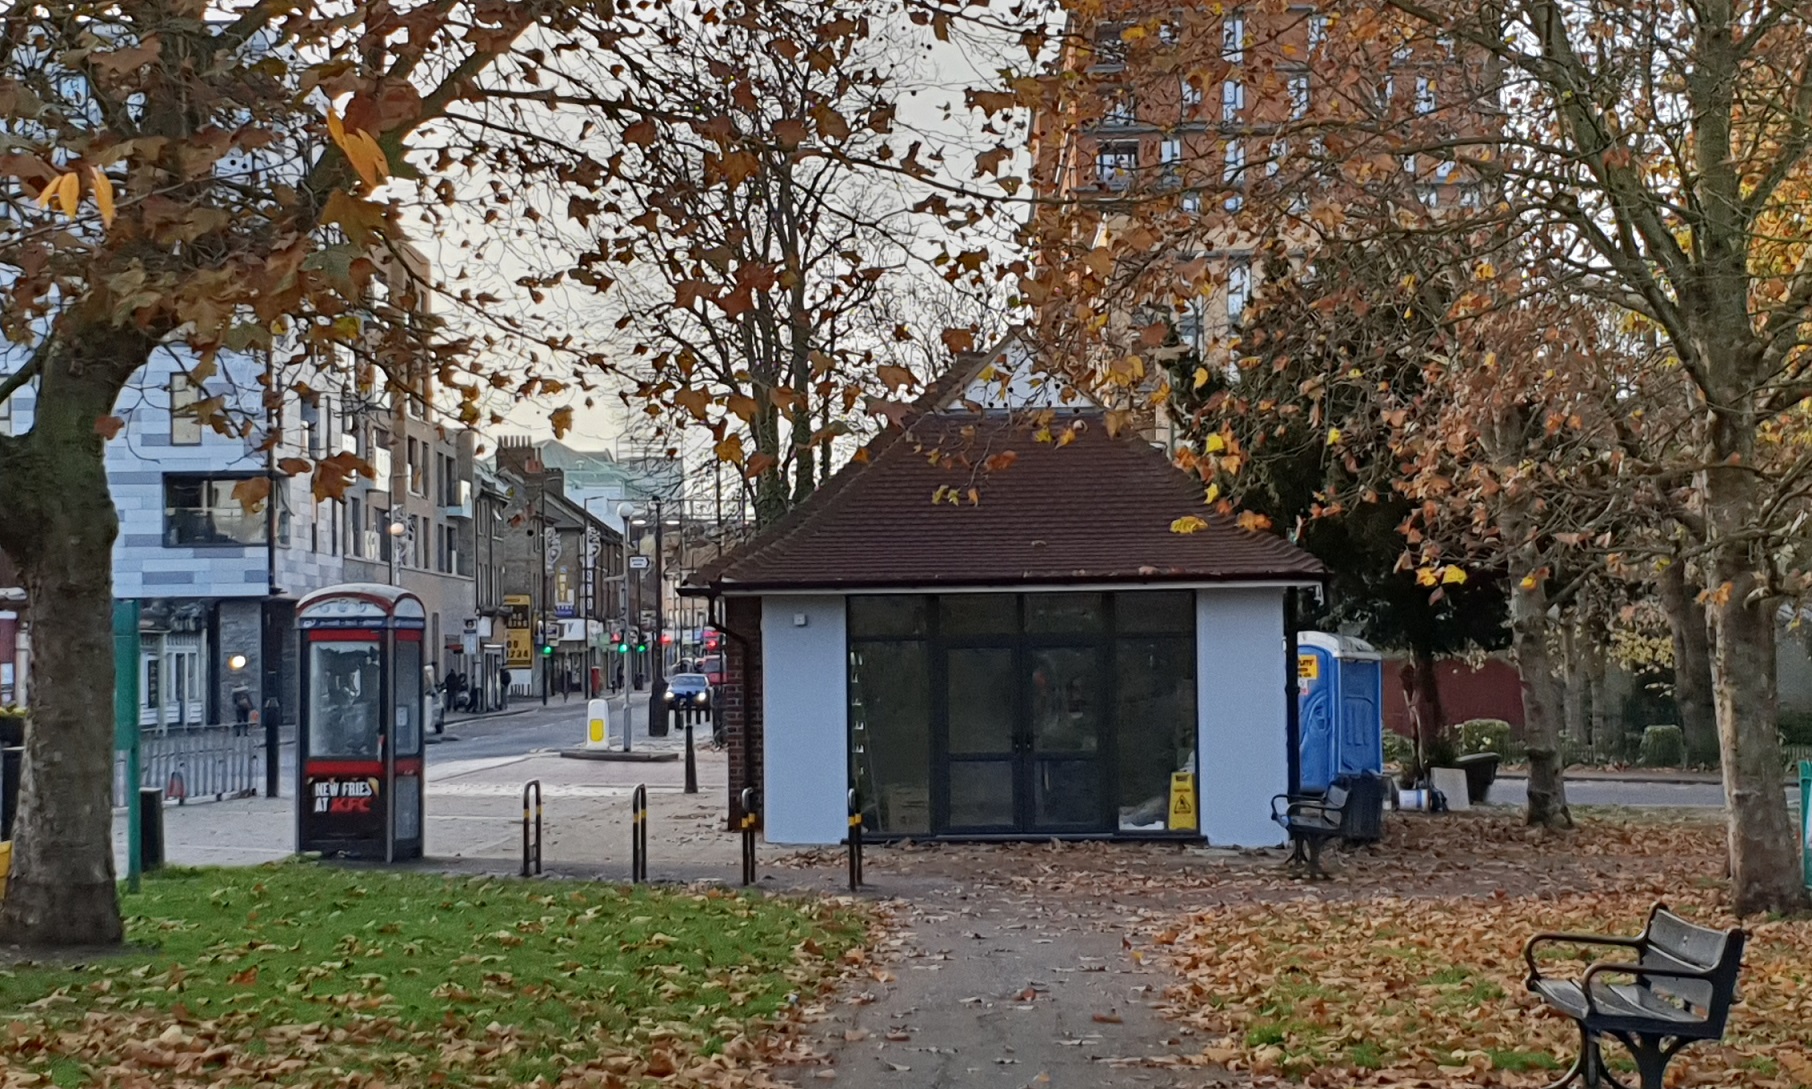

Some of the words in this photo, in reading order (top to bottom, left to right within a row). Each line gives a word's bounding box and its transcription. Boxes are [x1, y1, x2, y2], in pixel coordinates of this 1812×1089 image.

[314, 782, 340, 796] NEW
[342, 781, 372, 796] FRIES
[314, 797, 329, 812] AT
[331, 797, 371, 813] KFC
